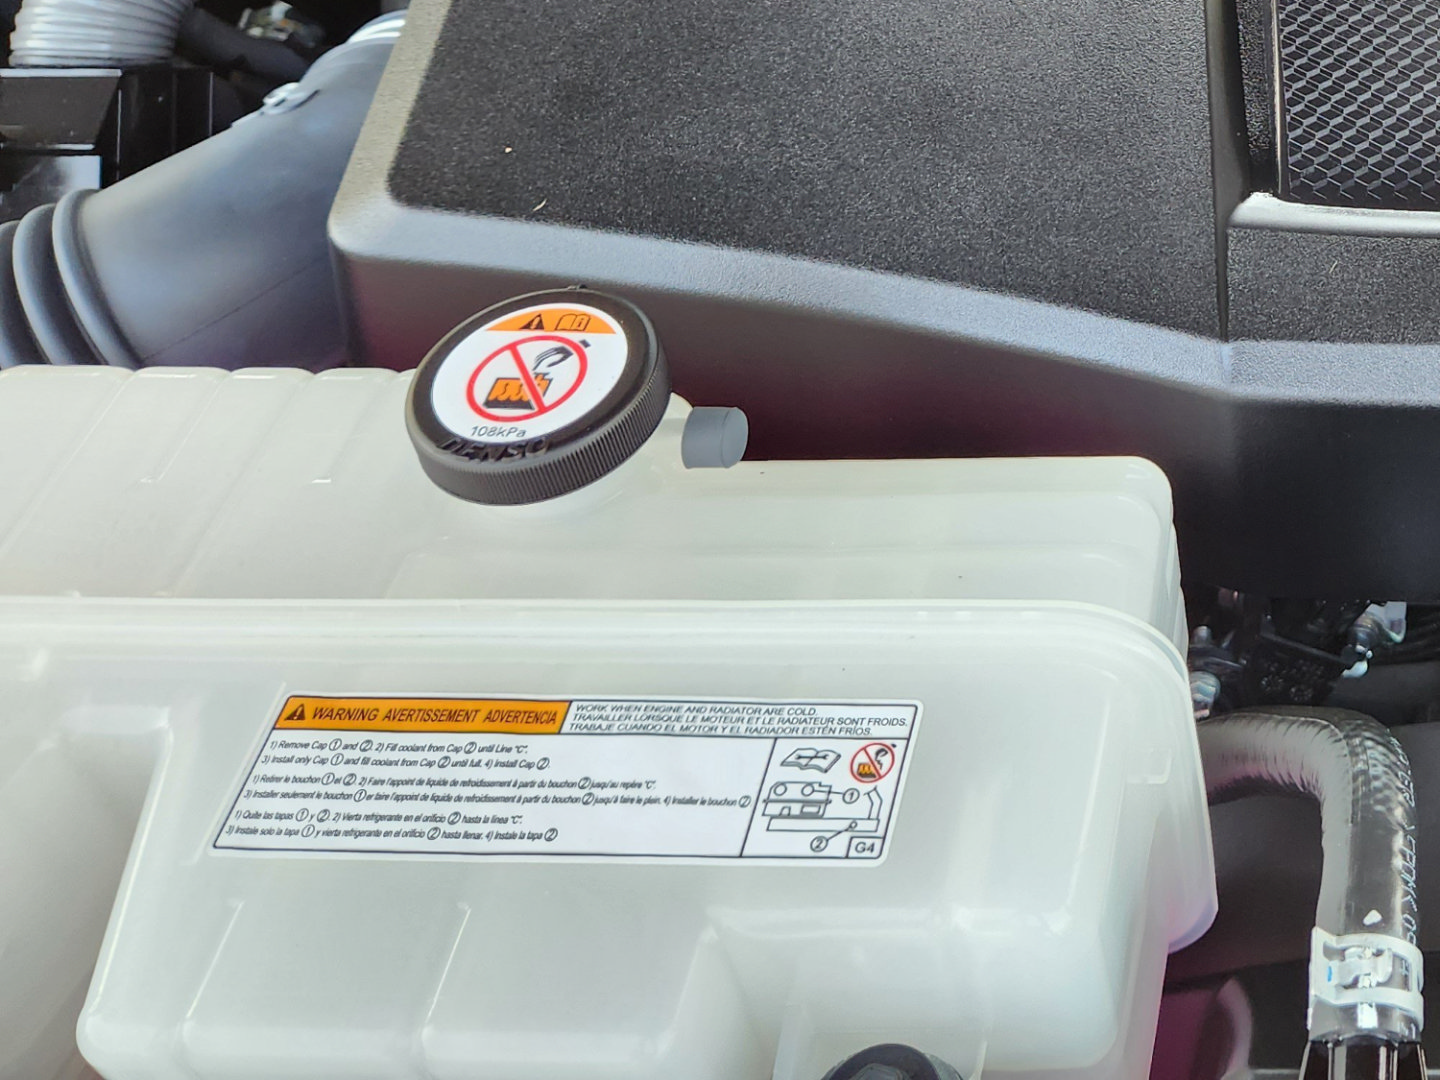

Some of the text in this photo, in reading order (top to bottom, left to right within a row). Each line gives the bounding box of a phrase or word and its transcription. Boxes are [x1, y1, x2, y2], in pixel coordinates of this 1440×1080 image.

[470, 426, 528, 438] 108kPa
[435, 437, 551, 463] DENSO
[312, 707, 558, 725] WARNING AVERTISSEMENT ADVERTENCIA
[576, 704, 607, 712] WORK
[644, 705, 683, 713] ENGINE
[685, 706, 707, 714] AND
[709, 706, 763, 715] RADIATOR
[763, 708, 784, 716] ARE
[787, 708, 819, 716] COLD.
[573, 713, 908, 727] TRAVAILLER LORSQUE LE MOTEUR ET LE RADIATEUR SONT FROIDS.
[570, 723, 873, 736] TRABAJE CUANDO EL MOTOR Y EL RADIADOR ESTÉN FRÍOS.
[270, 740, 278, 750] 1)
[278, 741, 310, 750] Remove
[311, 741, 329, 751] Cap
[342, 742, 358, 750] and
[374, 742, 385, 752] 2)
[385, 742, 399, 751] Fill
[399, 743, 426, 752] coolant
[427, 743, 445, 752] from
[447, 744, 463, 754] Cap
[477, 744, 494, 753] until
[495, 745, 513, 753] Line
[261, 754, 271, 764] 3)
[271, 755, 293, 764] Install
[294, 755, 311, 766] only
[312, 755, 329, 766] Cap
[344, 756, 360, 765] and
[361, 756, 370, 765] fill
[371, 757, 400, 766] coolant
[400, 758, 418, 767] from
[419, 758, 436, 768] Cap
[451, 759, 468, 767] until
[469, 759, 482, 768] full.
[484, 759, 493, 769] 4)
[494, 759, 517, 768] Install
[519, 759, 536, 770] Cap
[855, 842, 876, 853] G4
